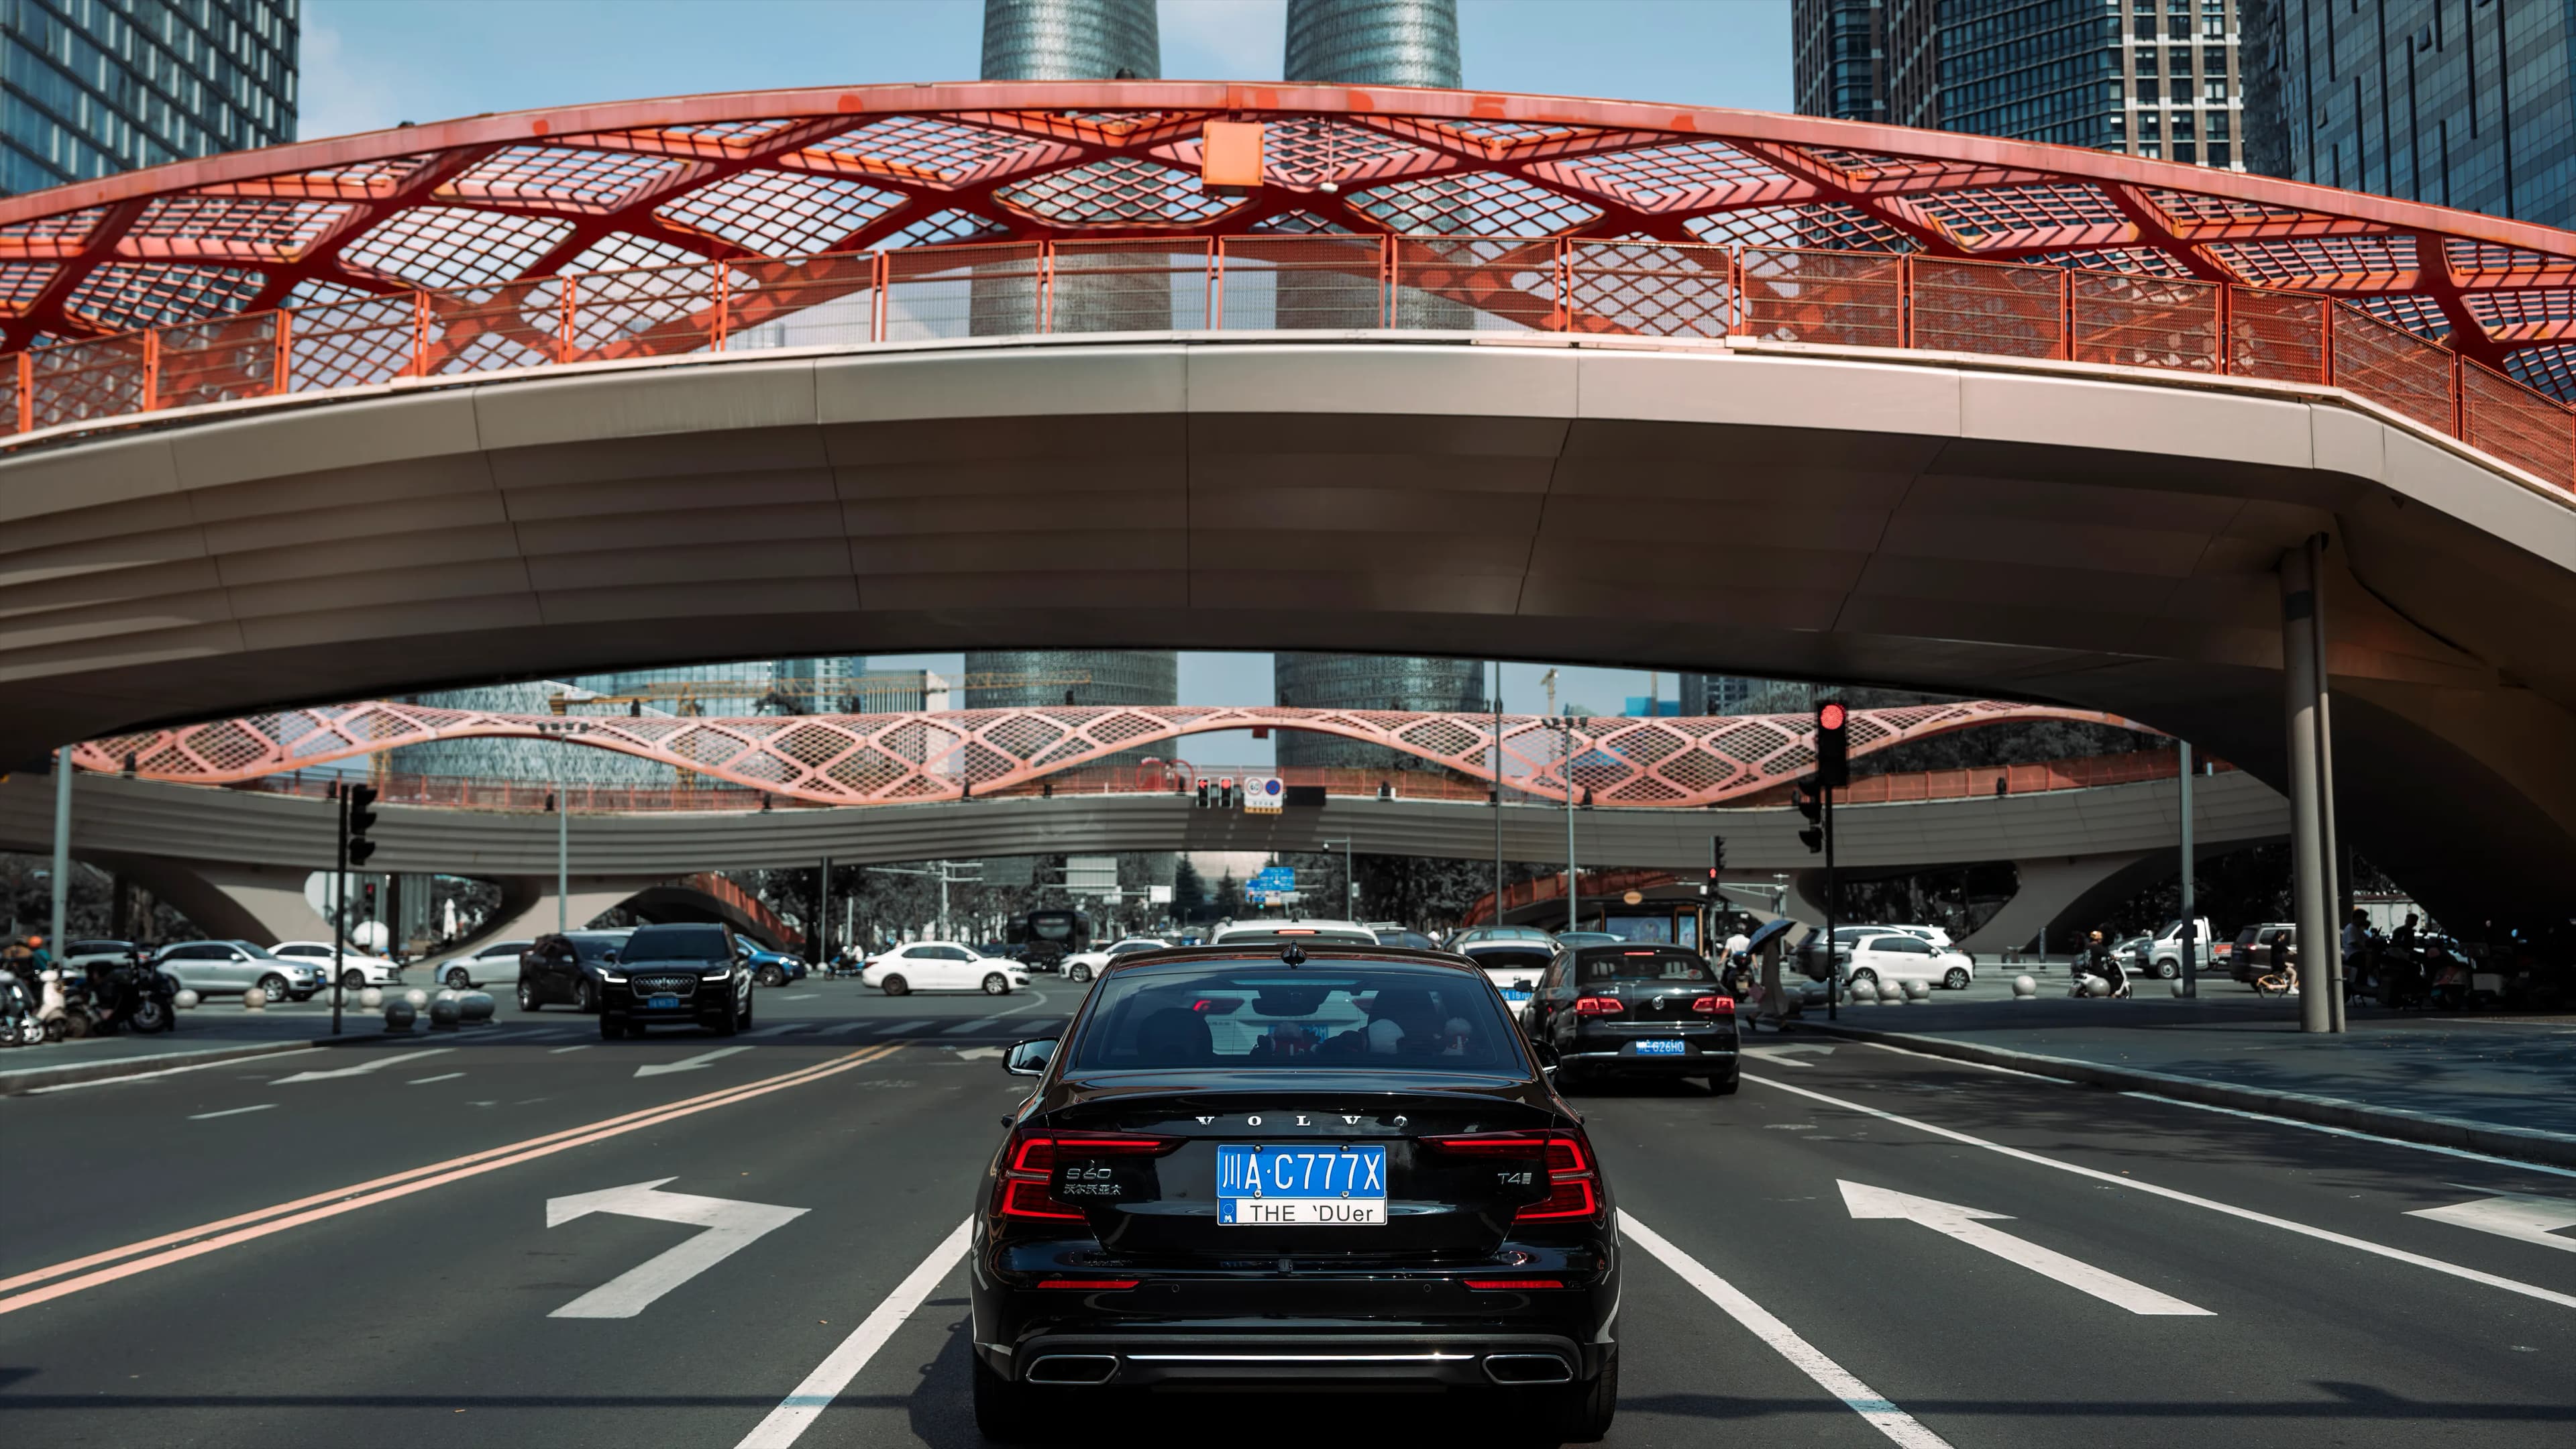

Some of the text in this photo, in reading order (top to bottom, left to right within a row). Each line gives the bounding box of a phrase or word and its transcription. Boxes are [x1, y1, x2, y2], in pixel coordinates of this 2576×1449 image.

[1196, 1115, 1408, 1126] VOLVO
[1067, 1168, 1112, 1179] S60
[1223, 1154, 1381, 1190] 川A·C777X
[1250, 1205, 1295, 1222] THE
